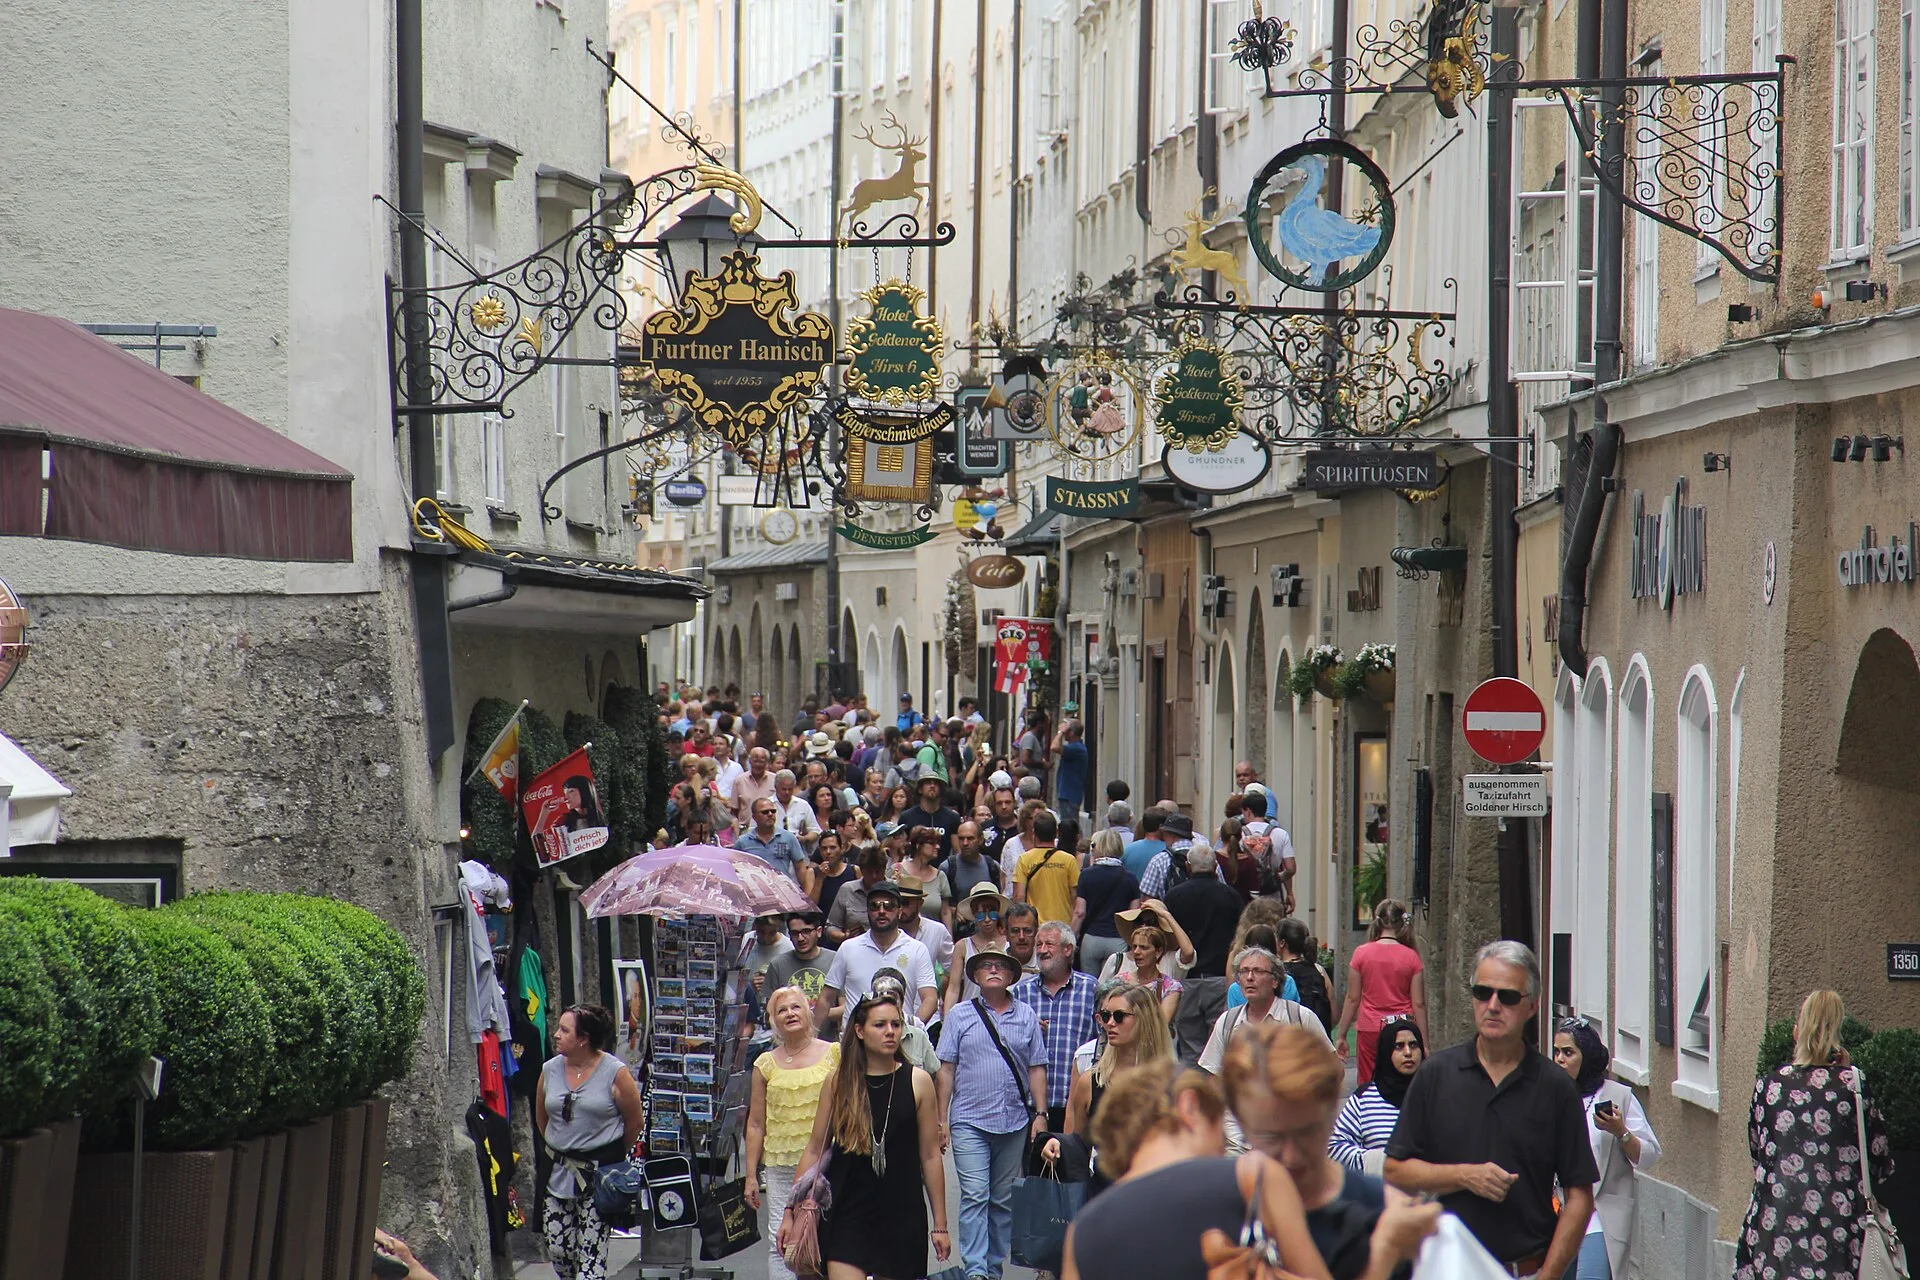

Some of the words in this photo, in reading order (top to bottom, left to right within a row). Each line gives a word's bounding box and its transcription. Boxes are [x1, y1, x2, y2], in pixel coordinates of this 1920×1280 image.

[875, 306, 912, 322] Hotel
[868, 332, 923, 347] Goldener
[651, 337, 733, 361] Furtner
[739, 338, 825, 362] Hanisch
[869, 358, 918, 374] Hirsch
[1183, 364, 1217, 378] Hotel
[712, 376, 732, 386] seit
[735, 376, 764, 387] 1955
[1174, 386, 1223, 401] Goldener
[836, 406, 951, 442] Kupferschmiedhaus
[1176, 409, 1216, 424] Hirsch
[1188, 456, 1246, 465] GMUNDNER
[1315, 465, 1429, 482] SPIRITUOSEN
[668, 483, 704, 495] Berlitz
[1054, 487, 1131, 509] STASSNY
[852, 529, 921, 545] DENKSTEIN
[999, 629, 1026, 640] EIS
[523, 784, 554, 803] Coca-Cola
[1468, 781, 1540, 791] ausgenommen
[1478, 791, 1531, 800] Taxizufahrt
[1465, 802, 1510, 812] Goldener
[1512, 802, 1544, 812] Hirsch
[573, 830, 601, 845] erfrisch
[575, 840, 591, 852] dich
[1893, 954, 1918, 970] 1350
